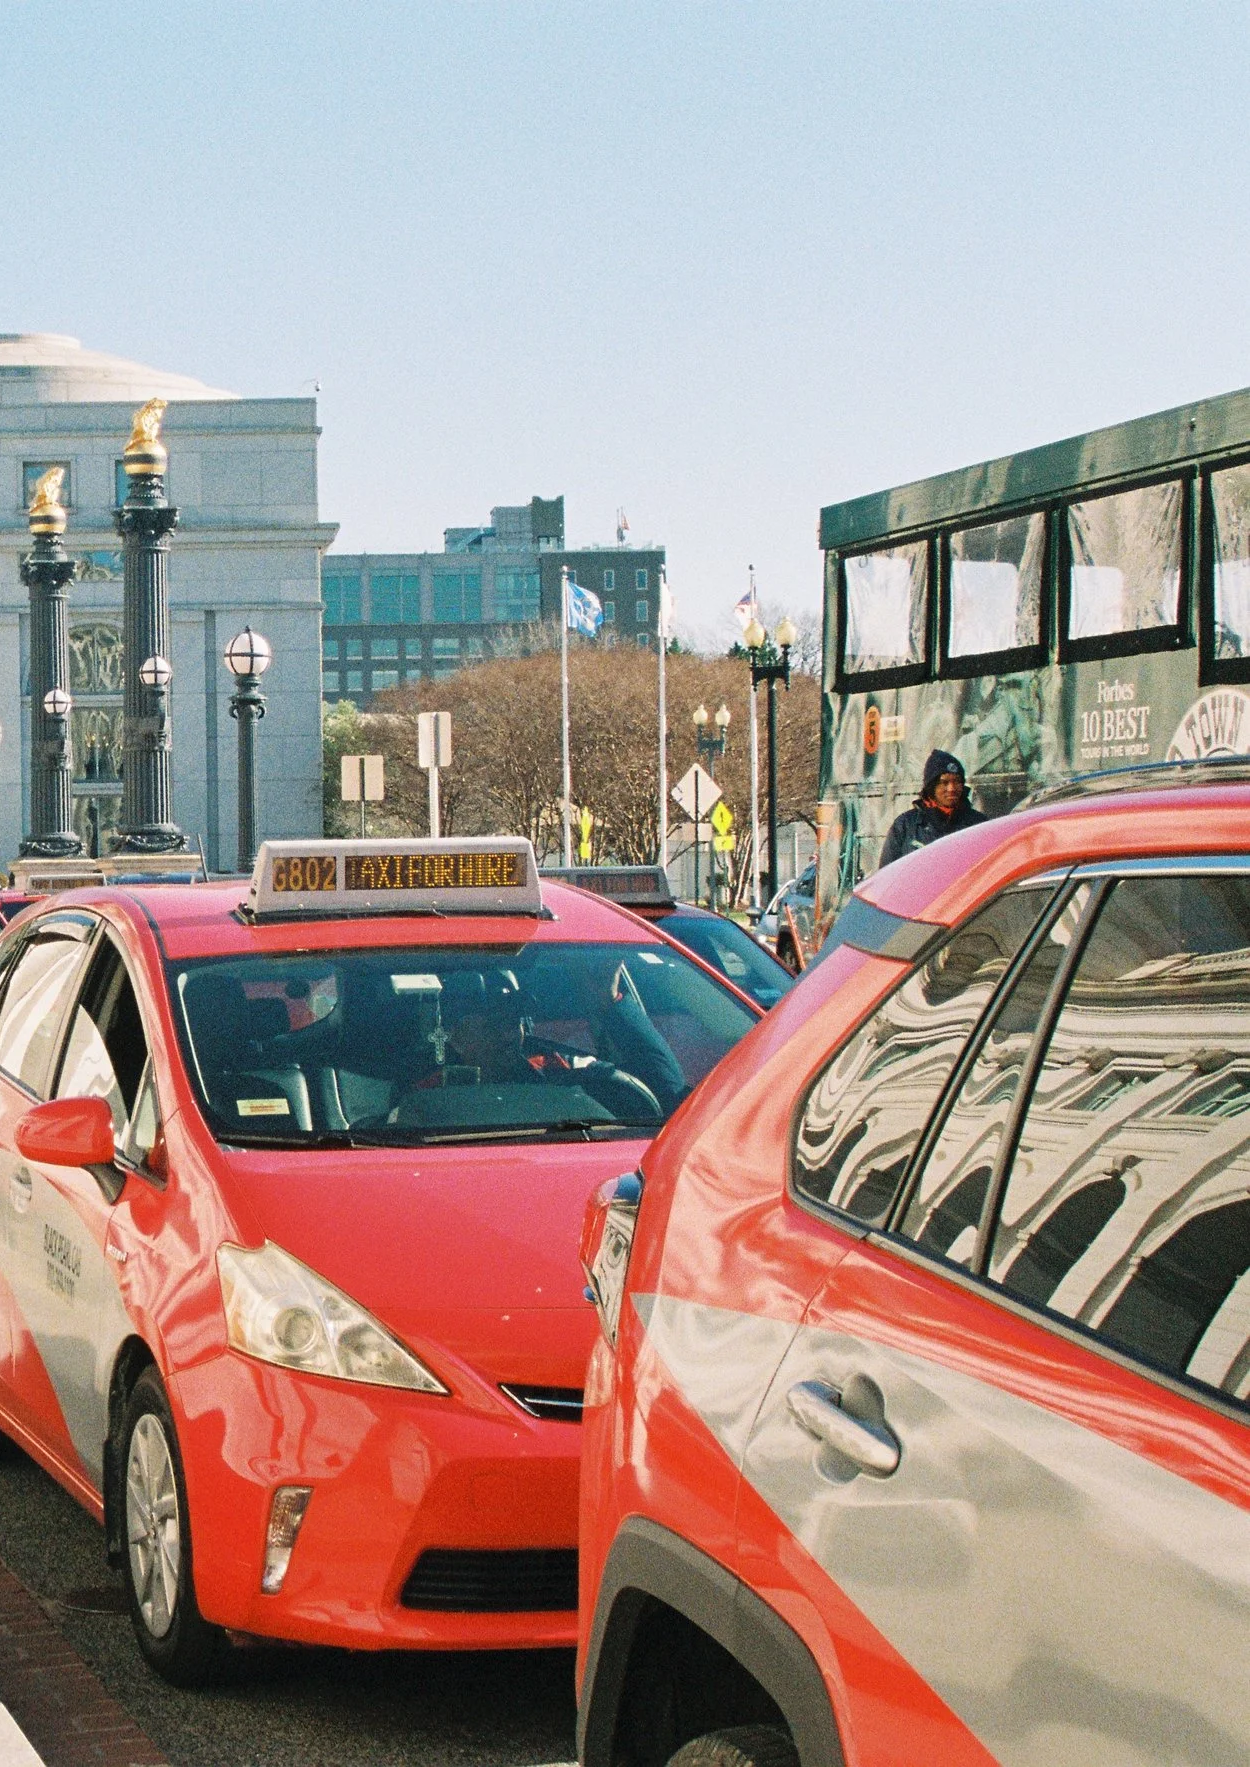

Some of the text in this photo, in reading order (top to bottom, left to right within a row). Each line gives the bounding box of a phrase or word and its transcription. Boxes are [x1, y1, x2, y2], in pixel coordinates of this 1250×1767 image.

[1097, 679, 1135, 703] Forbes
[1081, 706, 1150, 743] 10 BEST
[1184, 694, 1245, 759] TOWN
[1110, 745, 1124, 757] THE
[1125, 743, 1151, 756] WORLD
[273, 857, 337, 891] G802
[409, 855, 455, 887] FOR
[458, 853, 517, 886] HIRE
